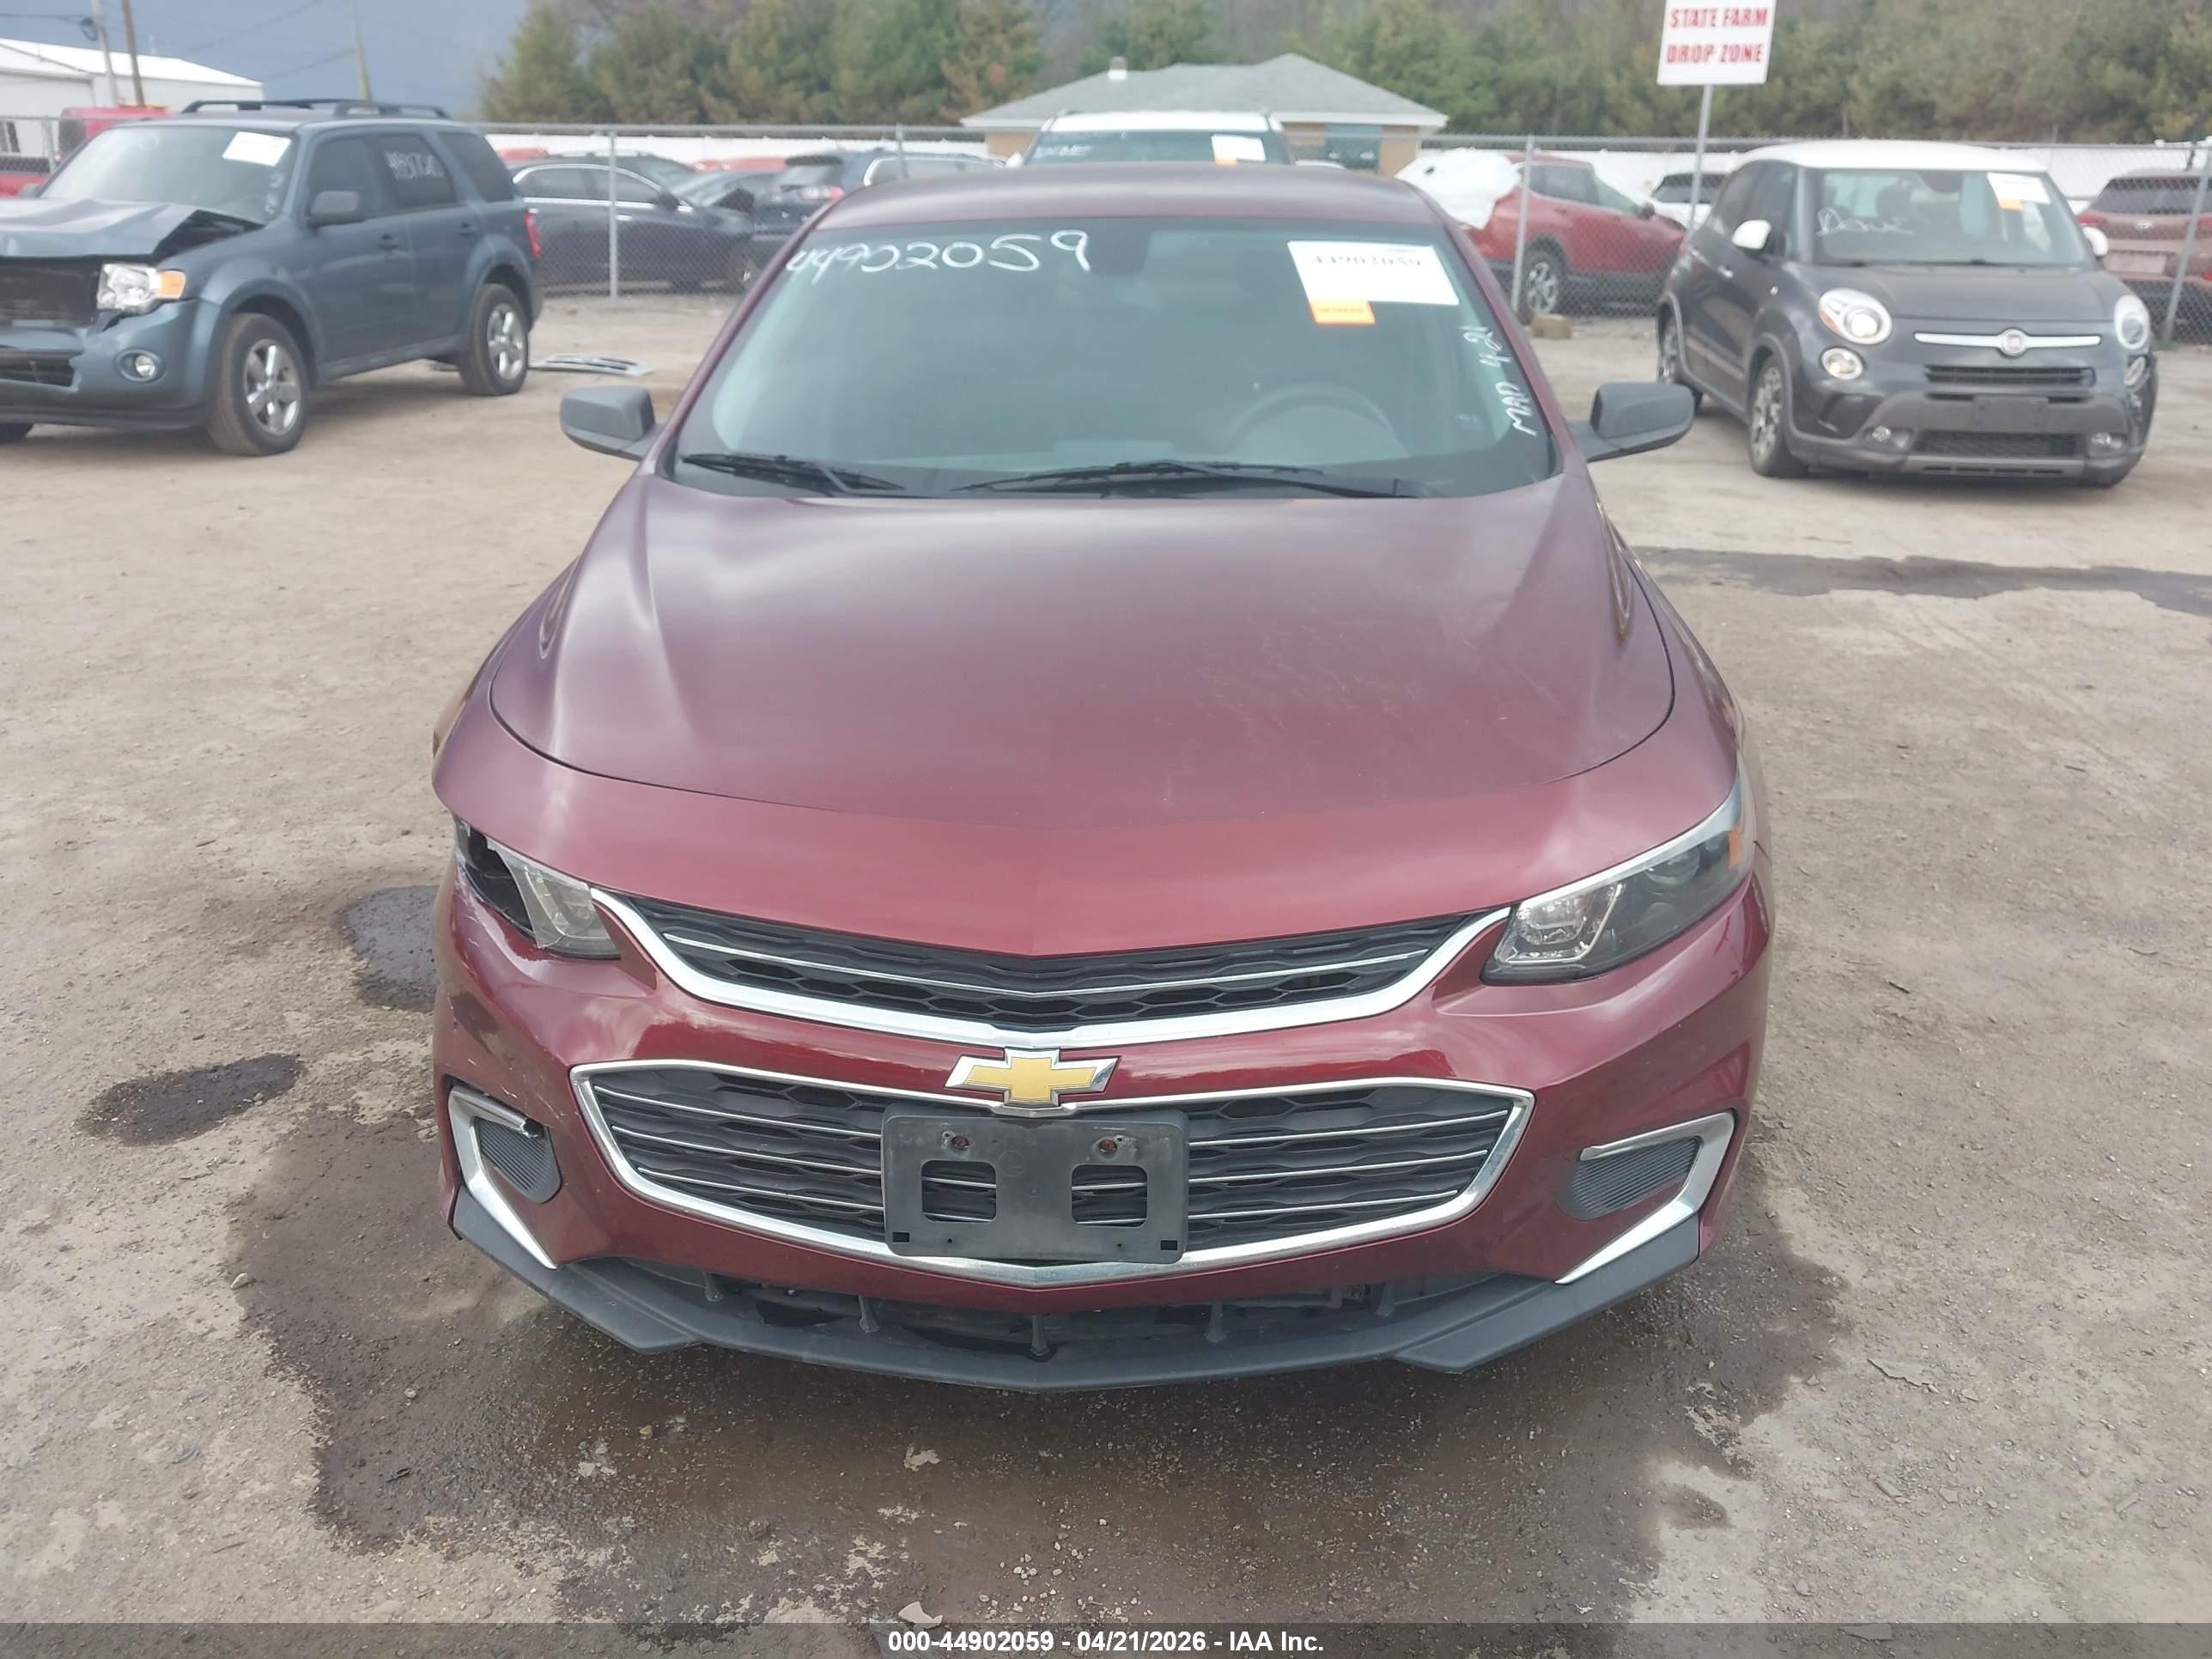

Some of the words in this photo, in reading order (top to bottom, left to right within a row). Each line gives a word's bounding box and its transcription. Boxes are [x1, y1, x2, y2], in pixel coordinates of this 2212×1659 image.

[1669, 8, 1717, 27] STATE
[1722, 8, 1768, 27] FARM
[1666, 43, 1715, 64] DROP
[1719, 43, 1763, 64] ZONE
